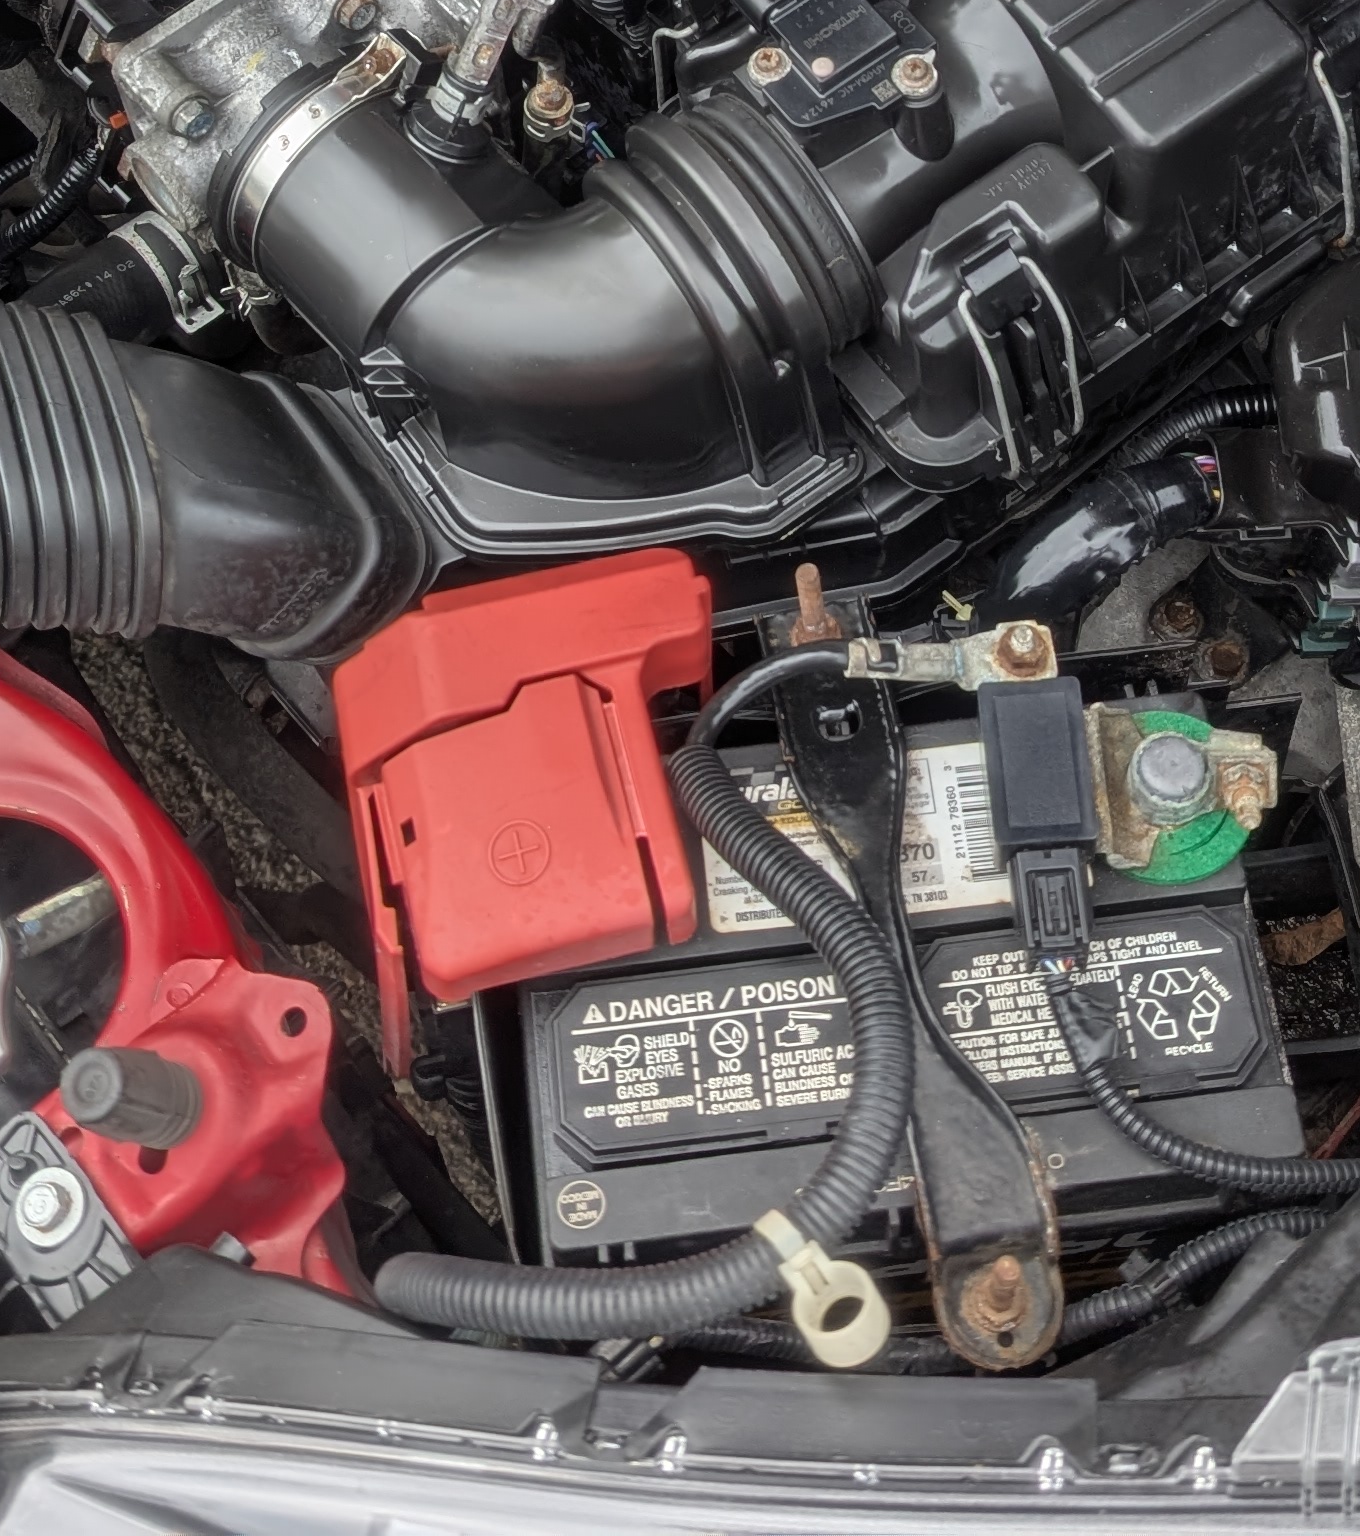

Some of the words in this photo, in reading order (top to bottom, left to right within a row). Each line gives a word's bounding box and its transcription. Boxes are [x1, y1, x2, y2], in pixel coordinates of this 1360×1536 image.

[802, 3, 867, 50] HITACHI
[739, 776, 798, 803] urala
[945, 785, 959, 819] 79360
[951, 823, 965, 858] 21112
[715, 874, 745, 884] Numbe
[735, 907, 785, 922] DISTRIBUTE
[973, 954, 999, 967] KEEP
[1002, 950, 1025, 963] OUT
[1107, 937, 1122, 949] OF
[1124, 929, 1177, 947] CHILDREN
[952, 970, 968, 981] DO
[971, 966, 993, 979] NOT
[1086, 951, 1108, 964] APS
[1111, 946, 1142, 960] TIGHT
[1145, 943, 1167, 956] AND
[1170, 939, 1202, 953] LEVEL
[985, 980, 1019, 997] FLUSH
[1127, 973, 1144, 999] LEAD
[1197, 966, 1233, 1002] RETURN
[608, 990, 713, 1022] DANGER
[719, 987, 735, 1008] /
[740, 974, 835, 1006] POISON
[988, 996, 1014, 1012] WITH
[1016, 991, 1051, 1008] WATE
[990, 1008, 1033, 1026] MEDICAL
[1035, 1005, 1053, 1019] HE
[644, 1031, 690, 1049] SHIELD
[998, 1032, 1018, 1044] FOR
[1020, 1029, 1044, 1042] SAFE
[1046, 1026, 1059, 1038] JU
[645, 1048, 678, 1064] EYES
[770, 1046, 833, 1066] SULFURIC
[836, 1044, 854, 1059] AC
[964, 1047, 997, 1061] OLLOW
[1165, 1041, 1213, 1057] RECYCLE
[615, 1062, 684, 1083] EXPLOSIVE
[717, 1058, 741, 1073] NO
[772, 1066, 796, 1080] CAN
[799, 1062, 836, 1076] CAUSE
[1006, 1065, 1045, 1081] SERVICE
[616, 1081, 659, 1100] GASES
[773, 1075, 835, 1093] BLINDNESS
[584, 1104, 605, 1118] CAN
[607, 1100, 638, 1115] CAUSE
[640, 1094, 694, 1111] BLINDNESS
[775, 1091, 818, 1107] SEVERE
[821, 1087, 850, 1101] BURN
[615, 1115, 631, 1127] OR
